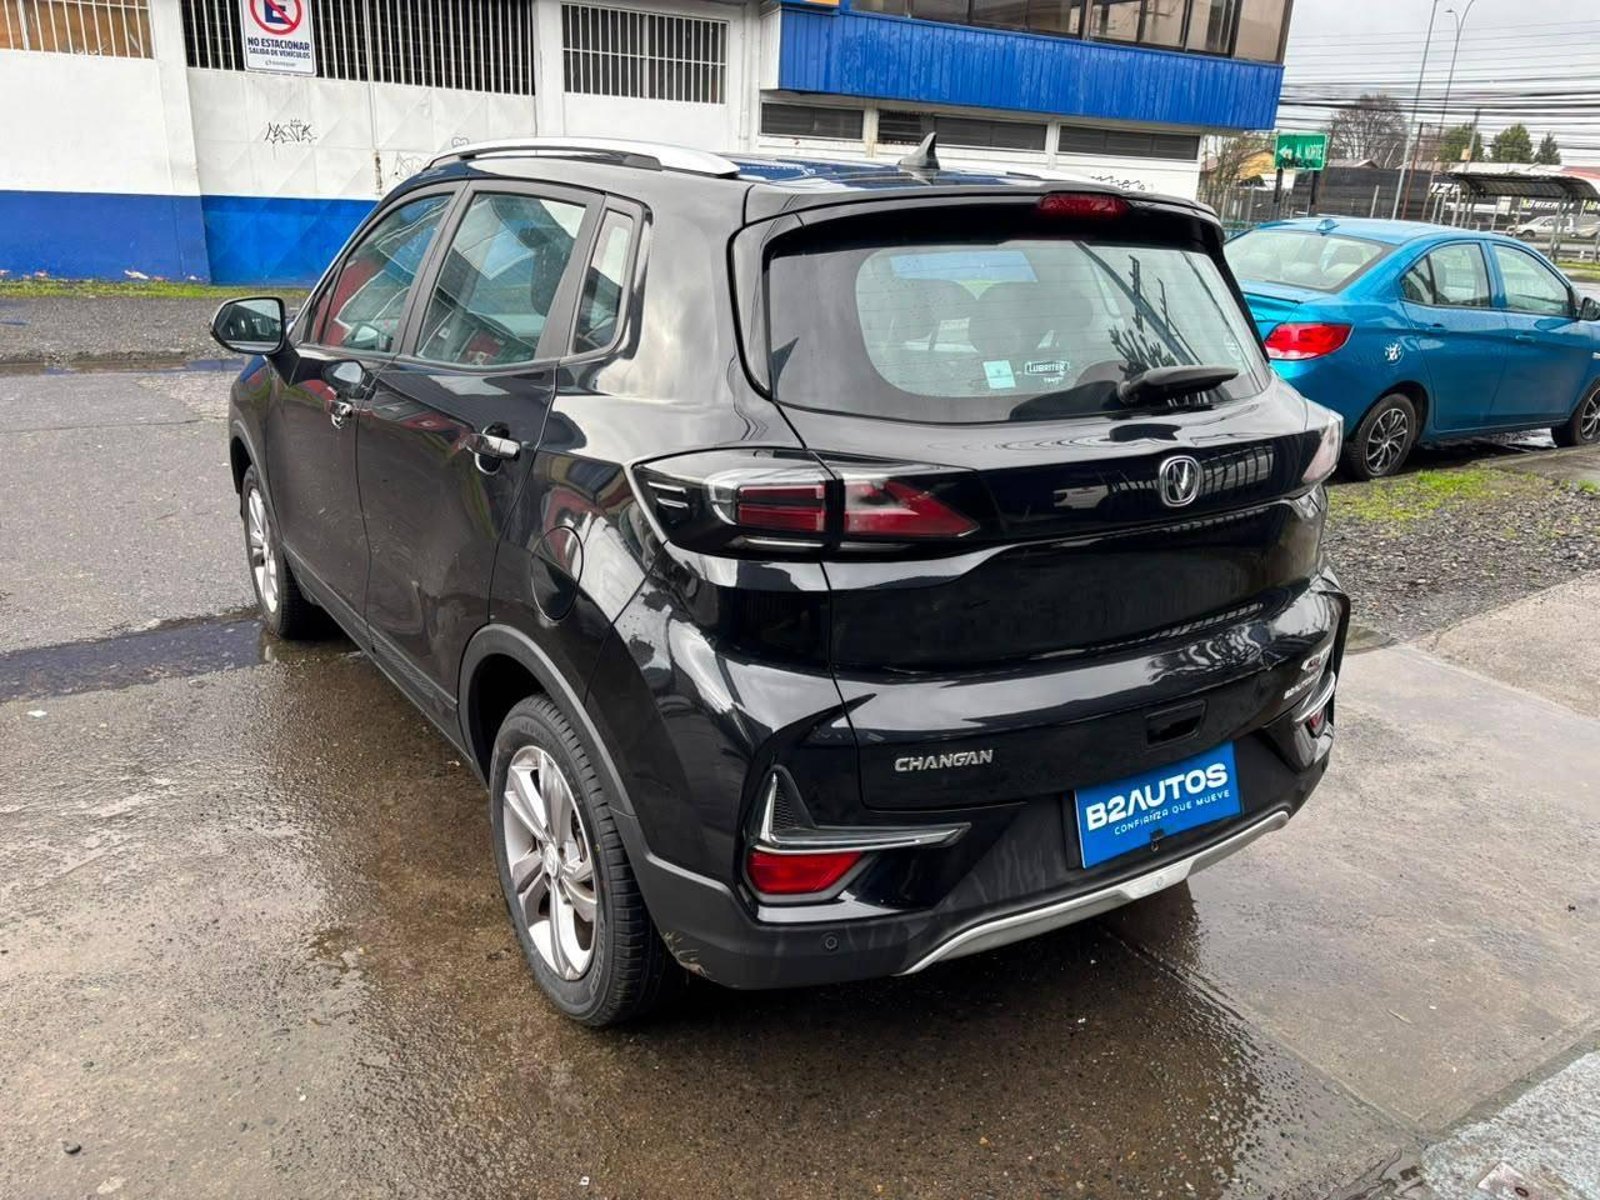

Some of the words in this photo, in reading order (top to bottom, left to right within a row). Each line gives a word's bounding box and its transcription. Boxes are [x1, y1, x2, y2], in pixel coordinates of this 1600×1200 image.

[247, 37, 259, 46] NO
[261, 38, 311, 51] ESTACIONAR
[249, 47, 270, 55] SALIDA
[895, 749, 993, 772] CHANGAN
[1085, 762, 1228, 831] B2AUTOS
[1114, 809, 1169, 835] CONFIANZA
[1172, 802, 1192, 814] QUE
[1196, 789, 1230, 806] MUEVE
